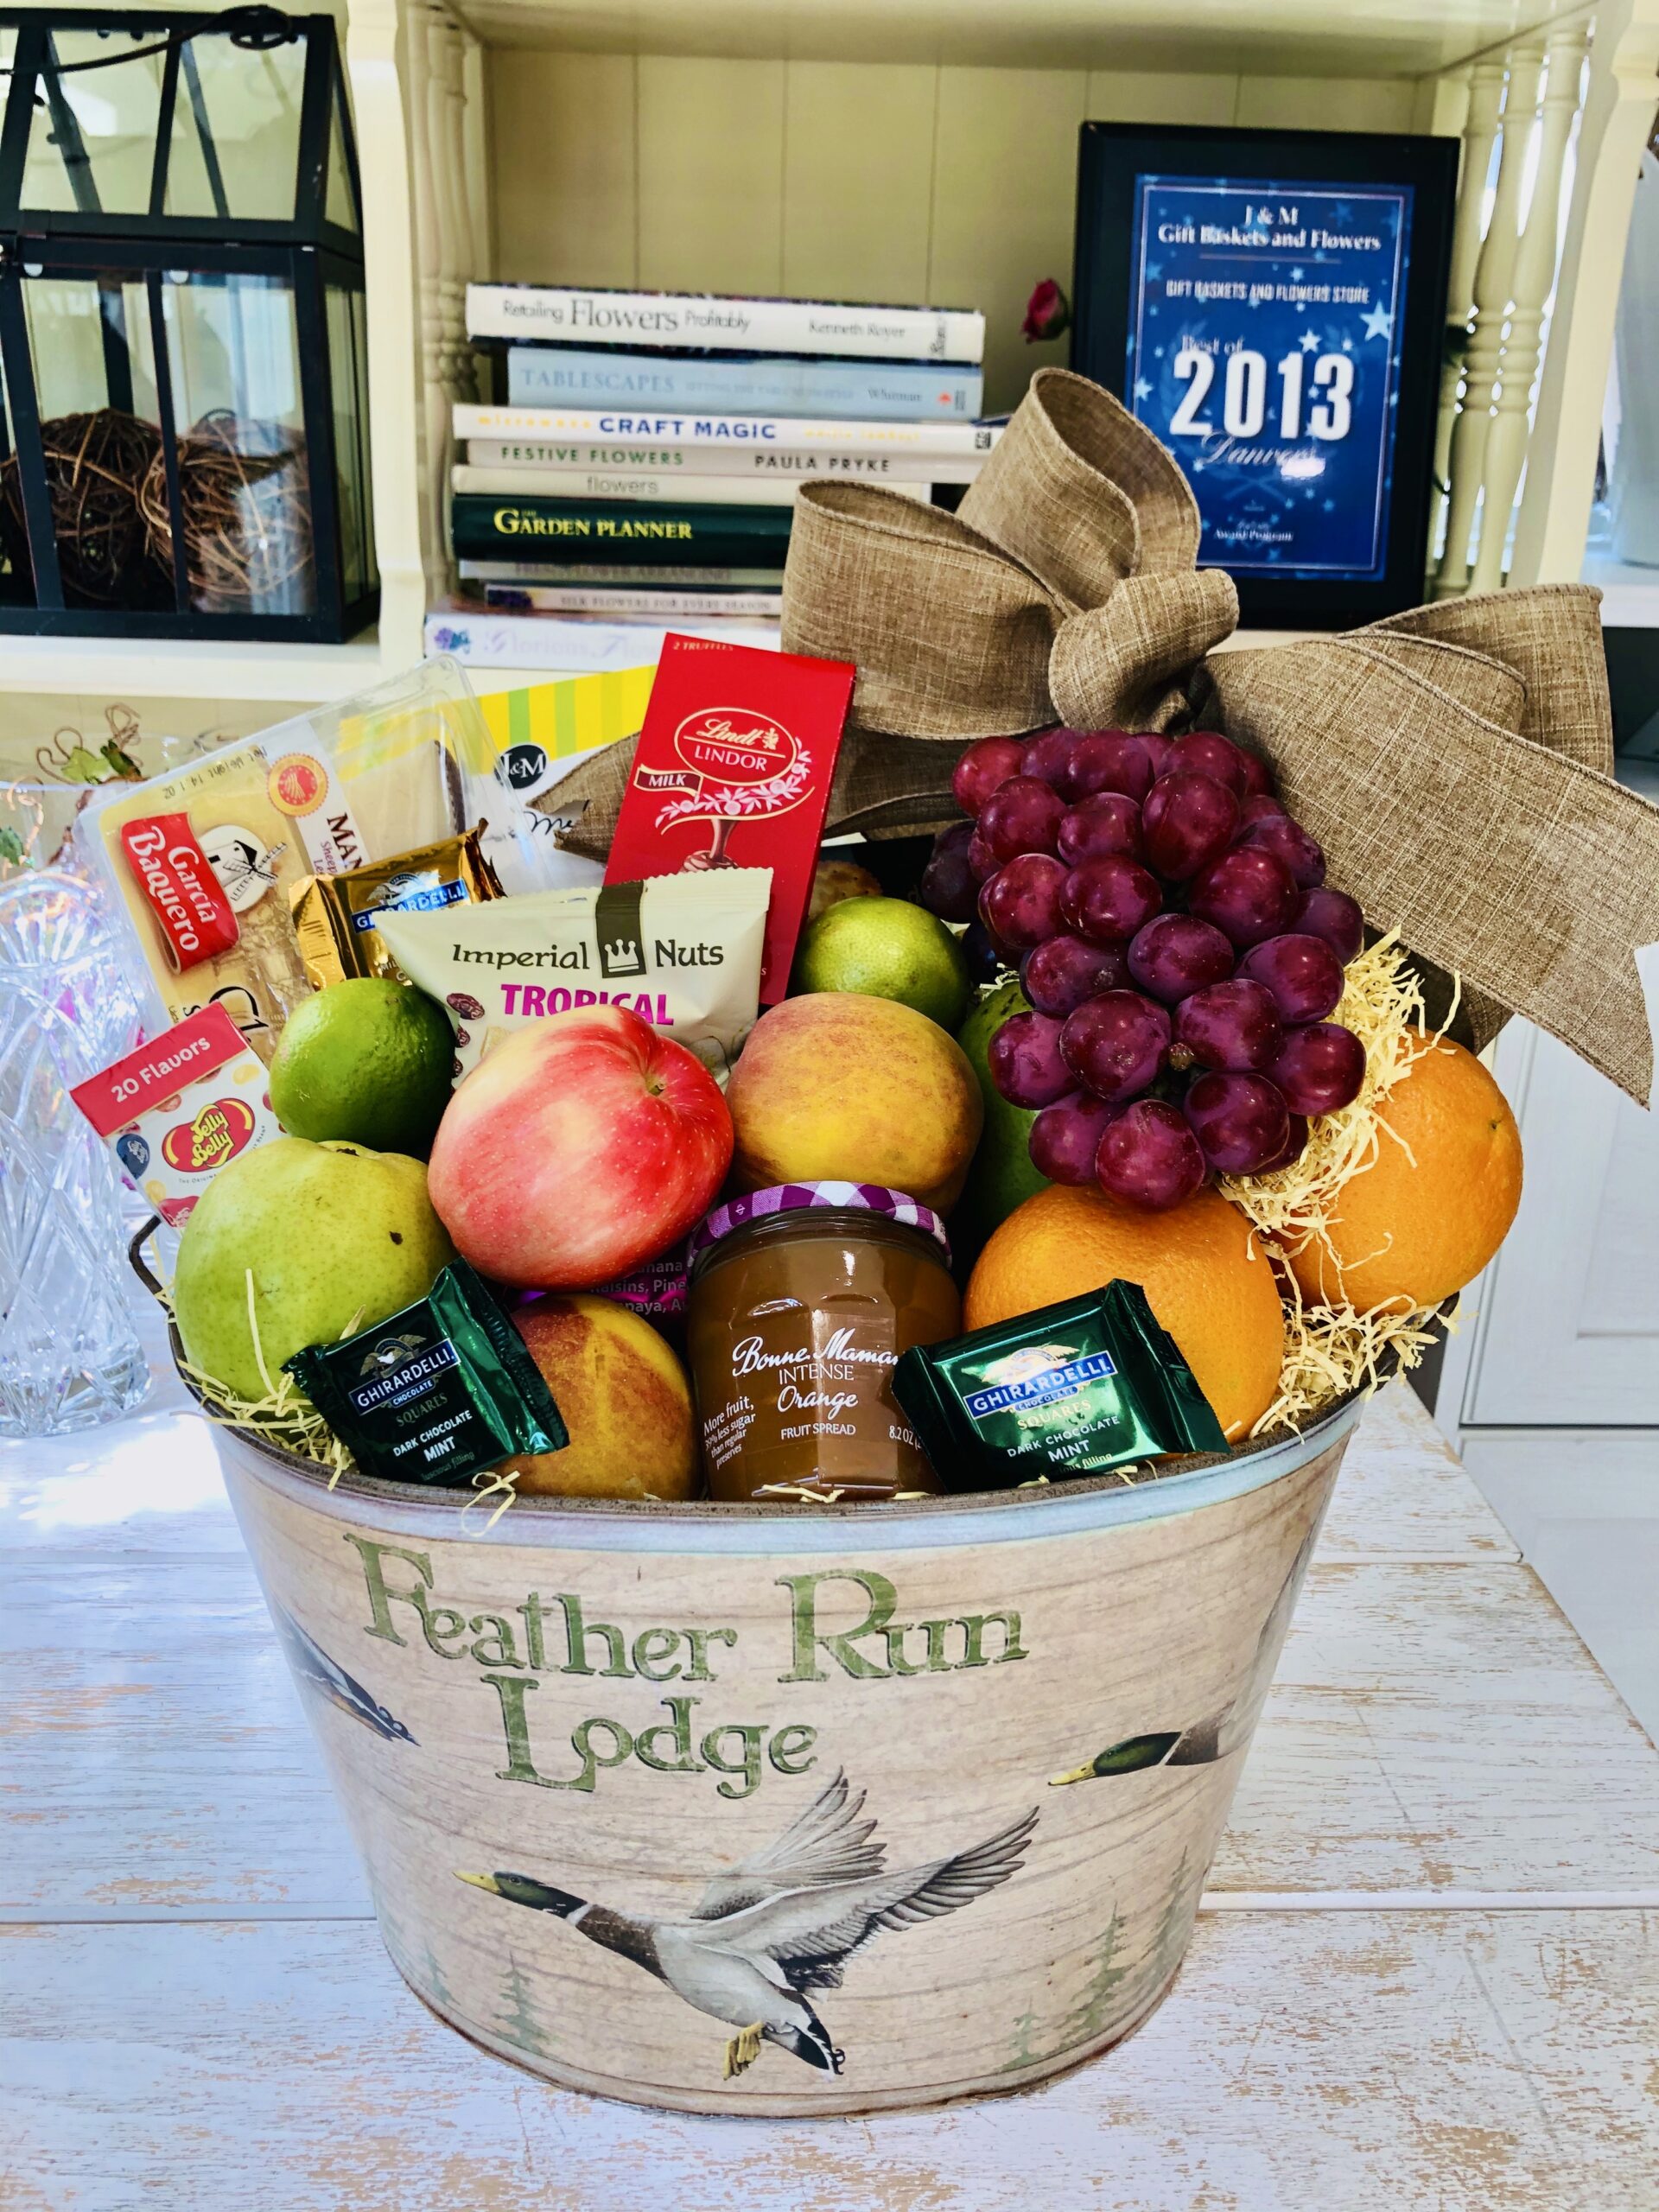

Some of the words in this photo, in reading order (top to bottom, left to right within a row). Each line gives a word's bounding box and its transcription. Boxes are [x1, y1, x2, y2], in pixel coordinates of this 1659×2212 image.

[1256, 207, 1274, 225] &
[1279, 207, 1300, 226] M
[1158, 223, 1196, 245] Gift
[1200, 225, 1268, 247] Baskets
[1271, 229, 1306, 249] and
[1310, 229, 1382, 251] Flowers
[1166, 279, 1192, 297] GIFT
[1194, 281, 1248, 300] BASKETS
[1249, 283, 1274, 301] AND
[1276, 284, 1331, 303] FLOWERS
[1332, 286, 1370, 304] STORE
[503, 299, 563, 323] Retailing
[570, 299, 678, 330] Flowers
[684, 309, 751, 334] Profitably
[809, 319, 862, 336] Kenneth
[522, 368, 676, 392] TABLESCAPES
[1169, 351, 1355, 441] 2013
[600, 417, 685, 436] CRAFT
[695, 421, 776, 440] MAGIC
[501, 446, 578, 461] FESTIVE
[590, 448, 683, 465] FLOWERS
[754, 454, 817, 470] PAULA
[829, 457, 890, 473] PRYKE
[586, 475, 659, 495] flowers
[493, 507, 590, 537] GARDEN
[596, 518, 692, 540] PLANNER
[592, 596, 649, 607] FLOWERS
[654, 598, 677, 608] FOR
[672, 641, 681, 651] 2
[683, 642, 734, 652] TRUFFLES
[695, 718, 763, 747] Lindt
[695, 746, 767, 772] LINDOR
[648, 773, 687, 788] MILK
[168, 846, 219, 923] García
[357, 885, 466, 928] GARDELLI
[452, 941, 589, 970] Imperial
[655, 940, 724, 967] Nuts
[111, 1077, 140, 1103] 20
[139, 1037, 211, 1085] Flavors
[190, 1110, 228, 1145] Jelly
[191, 1130, 232, 1167] Belly
[636, 1262, 683, 1274] nana
[591, 1280, 650, 1294] aisins,
[620, 1301, 668, 1315] paya,
[732, 1336, 810, 1376] Bonne
[358, 1347, 452, 1408] GHIRARDELLI
[779, 1363, 855, 1384] INTENSE
[973, 1357, 1109, 1412] GHIRARDELLI
[392, 1380, 434, 1406] CHOCOLATE
[777, 1385, 858, 1421] Orange
[1018, 1389, 1076, 1410] CHOCOLATE
[396, 1392, 448, 1427] SQUARES
[703, 1412, 725, 1436] More
[726, 1395, 754, 1418] fruit,
[1017, 1399, 1091, 1430] SQUARES
[393, 1438, 419, 1457] DARK
[420, 1410, 473, 1443] CHOCOLATE
[717, 1426, 730, 1440] less
[730, 1414, 756, 1430] sugar
[780, 1426, 810, 1440] FRUIT
[812, 1422, 856, 1436] SPREAD
[1007, 1440, 1042, 1458] DARK
[1046, 1415, 1120, 1445] CHOCOLATE
[423, 1436, 455, 1462] MINT
[711, 1443, 724, 1458] than
[724, 1429, 747, 1448] regular
[716, 1444, 742, 1470] preserves
[1047, 1440, 1090, 1463] MINT
[342, 1532, 738, 1683] Feather
[774, 1567, 1030, 1683] Run
[479, 1674, 819, 1799] Lodge
